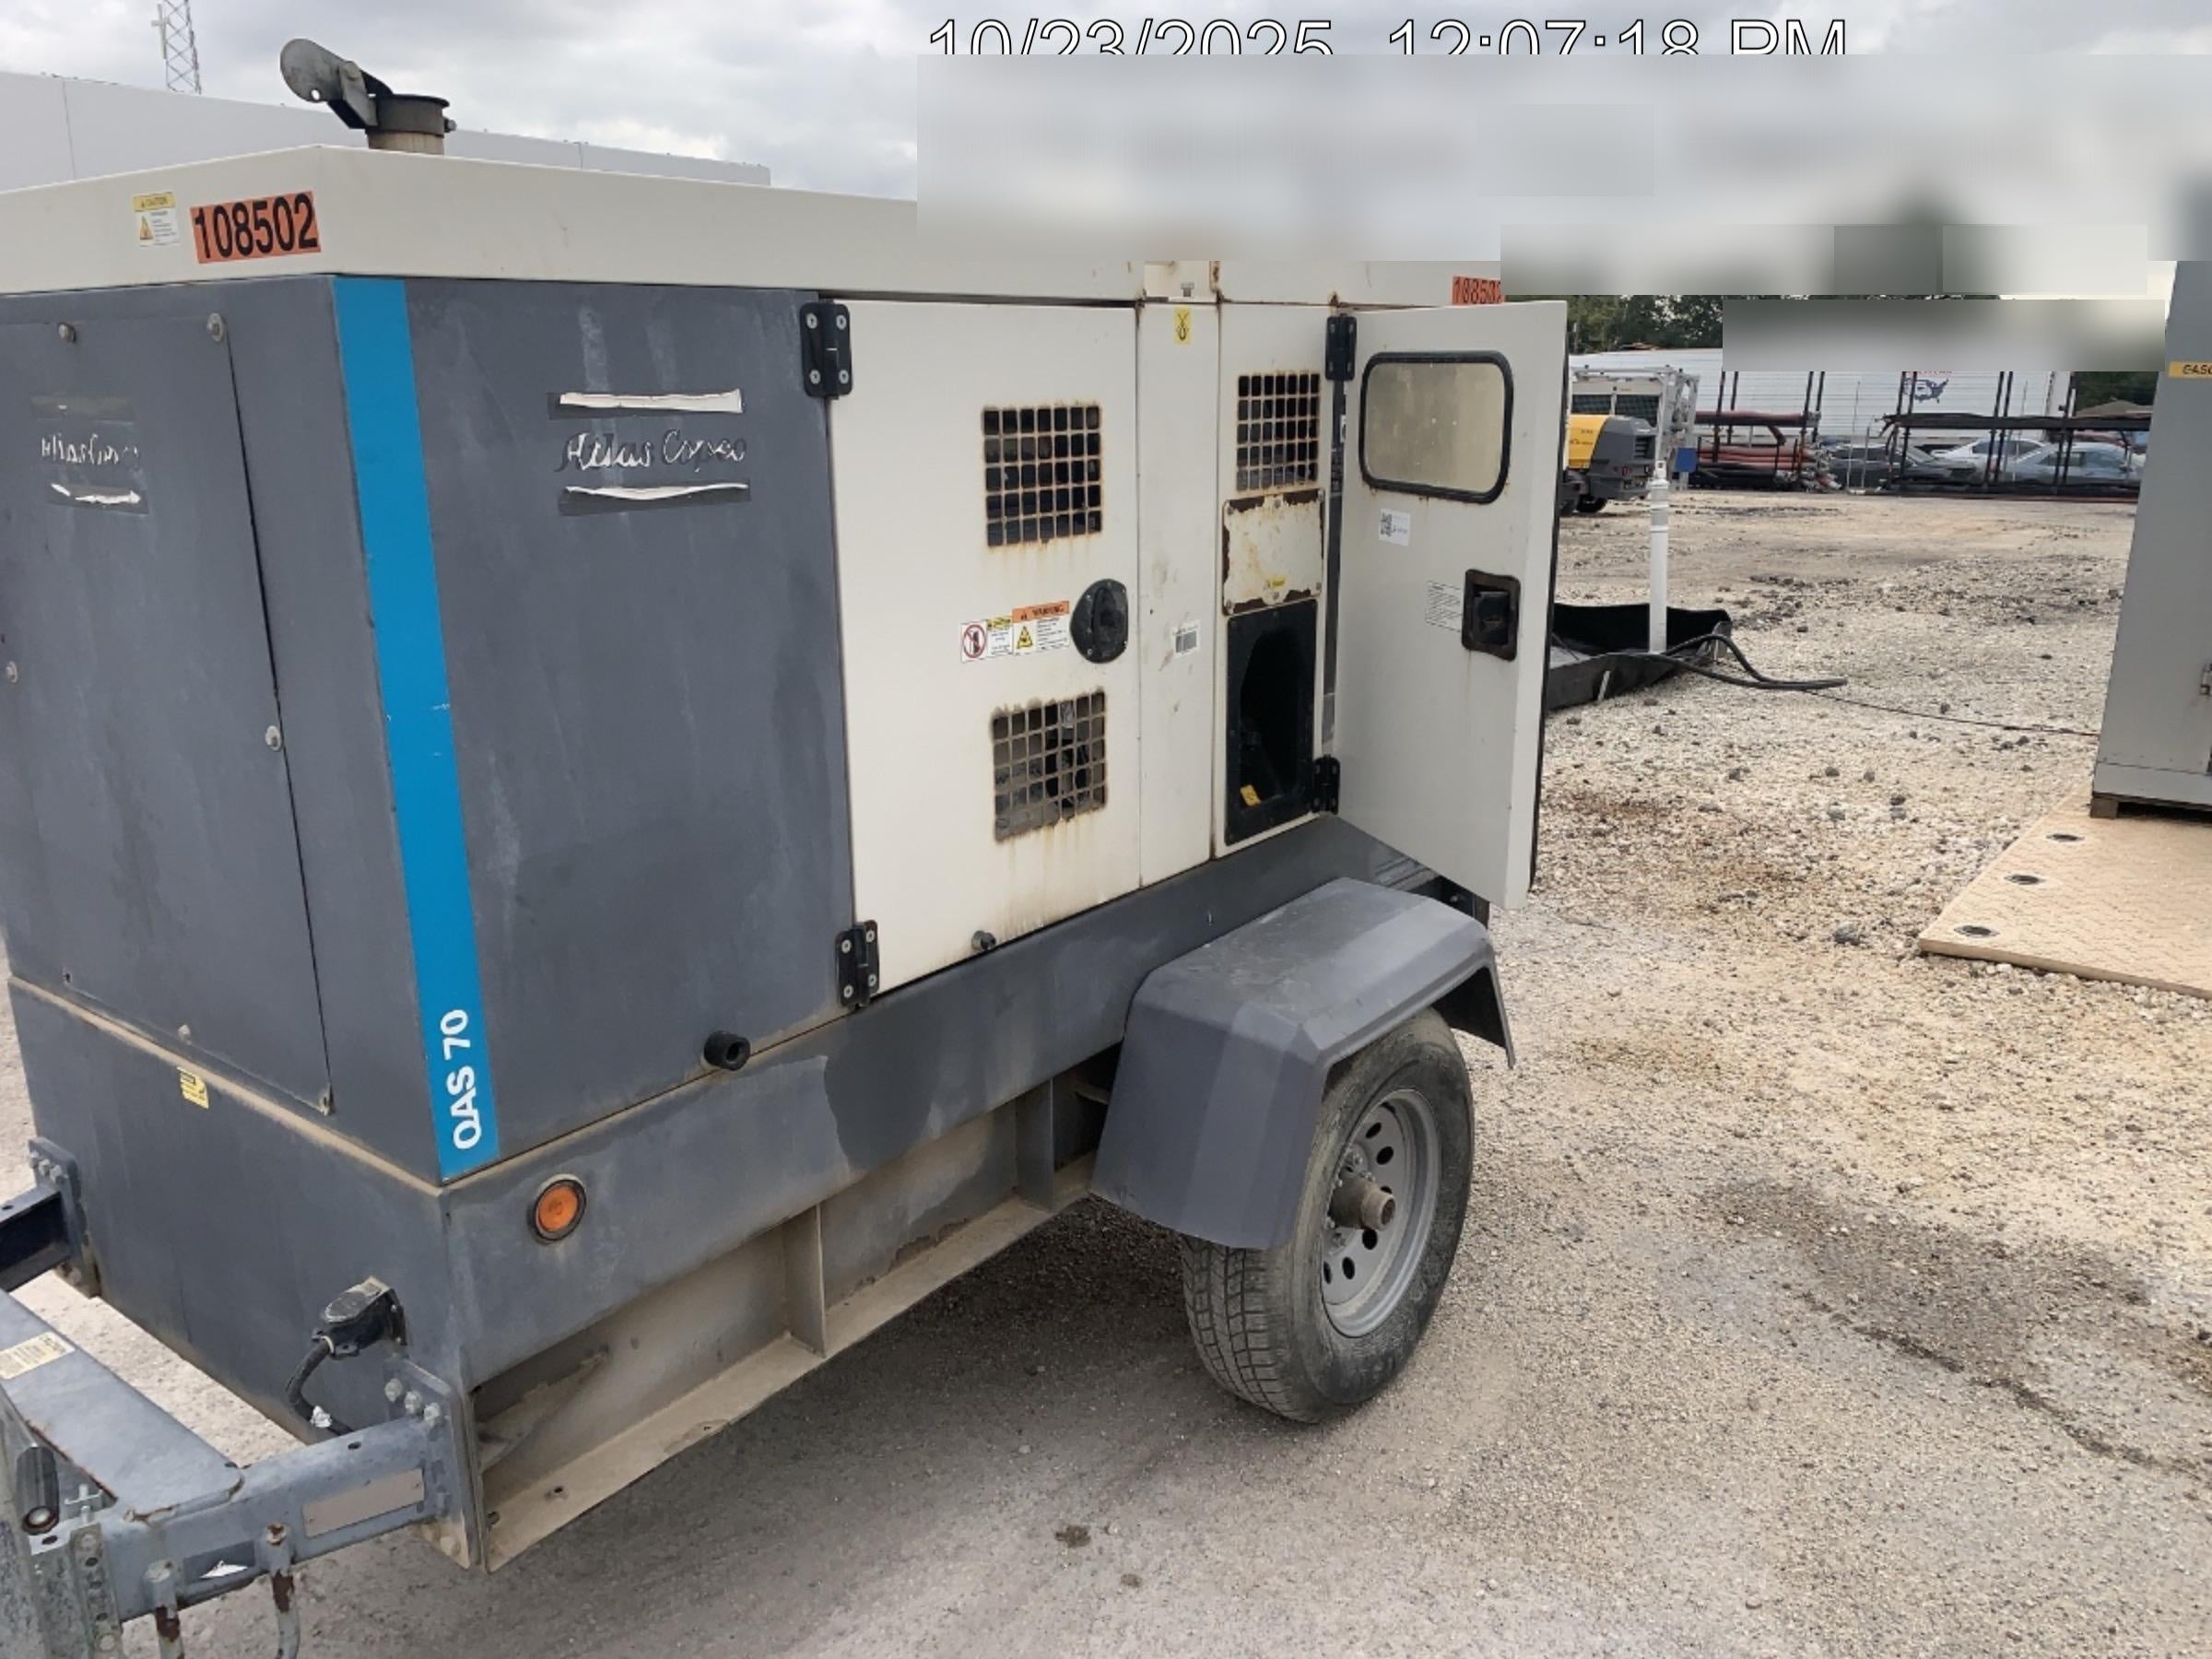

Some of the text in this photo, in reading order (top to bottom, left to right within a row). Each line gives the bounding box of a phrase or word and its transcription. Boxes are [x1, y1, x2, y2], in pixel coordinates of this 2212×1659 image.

[194, 193, 318, 259] 108502
[440, 1009, 482, 1149] QAS 70
